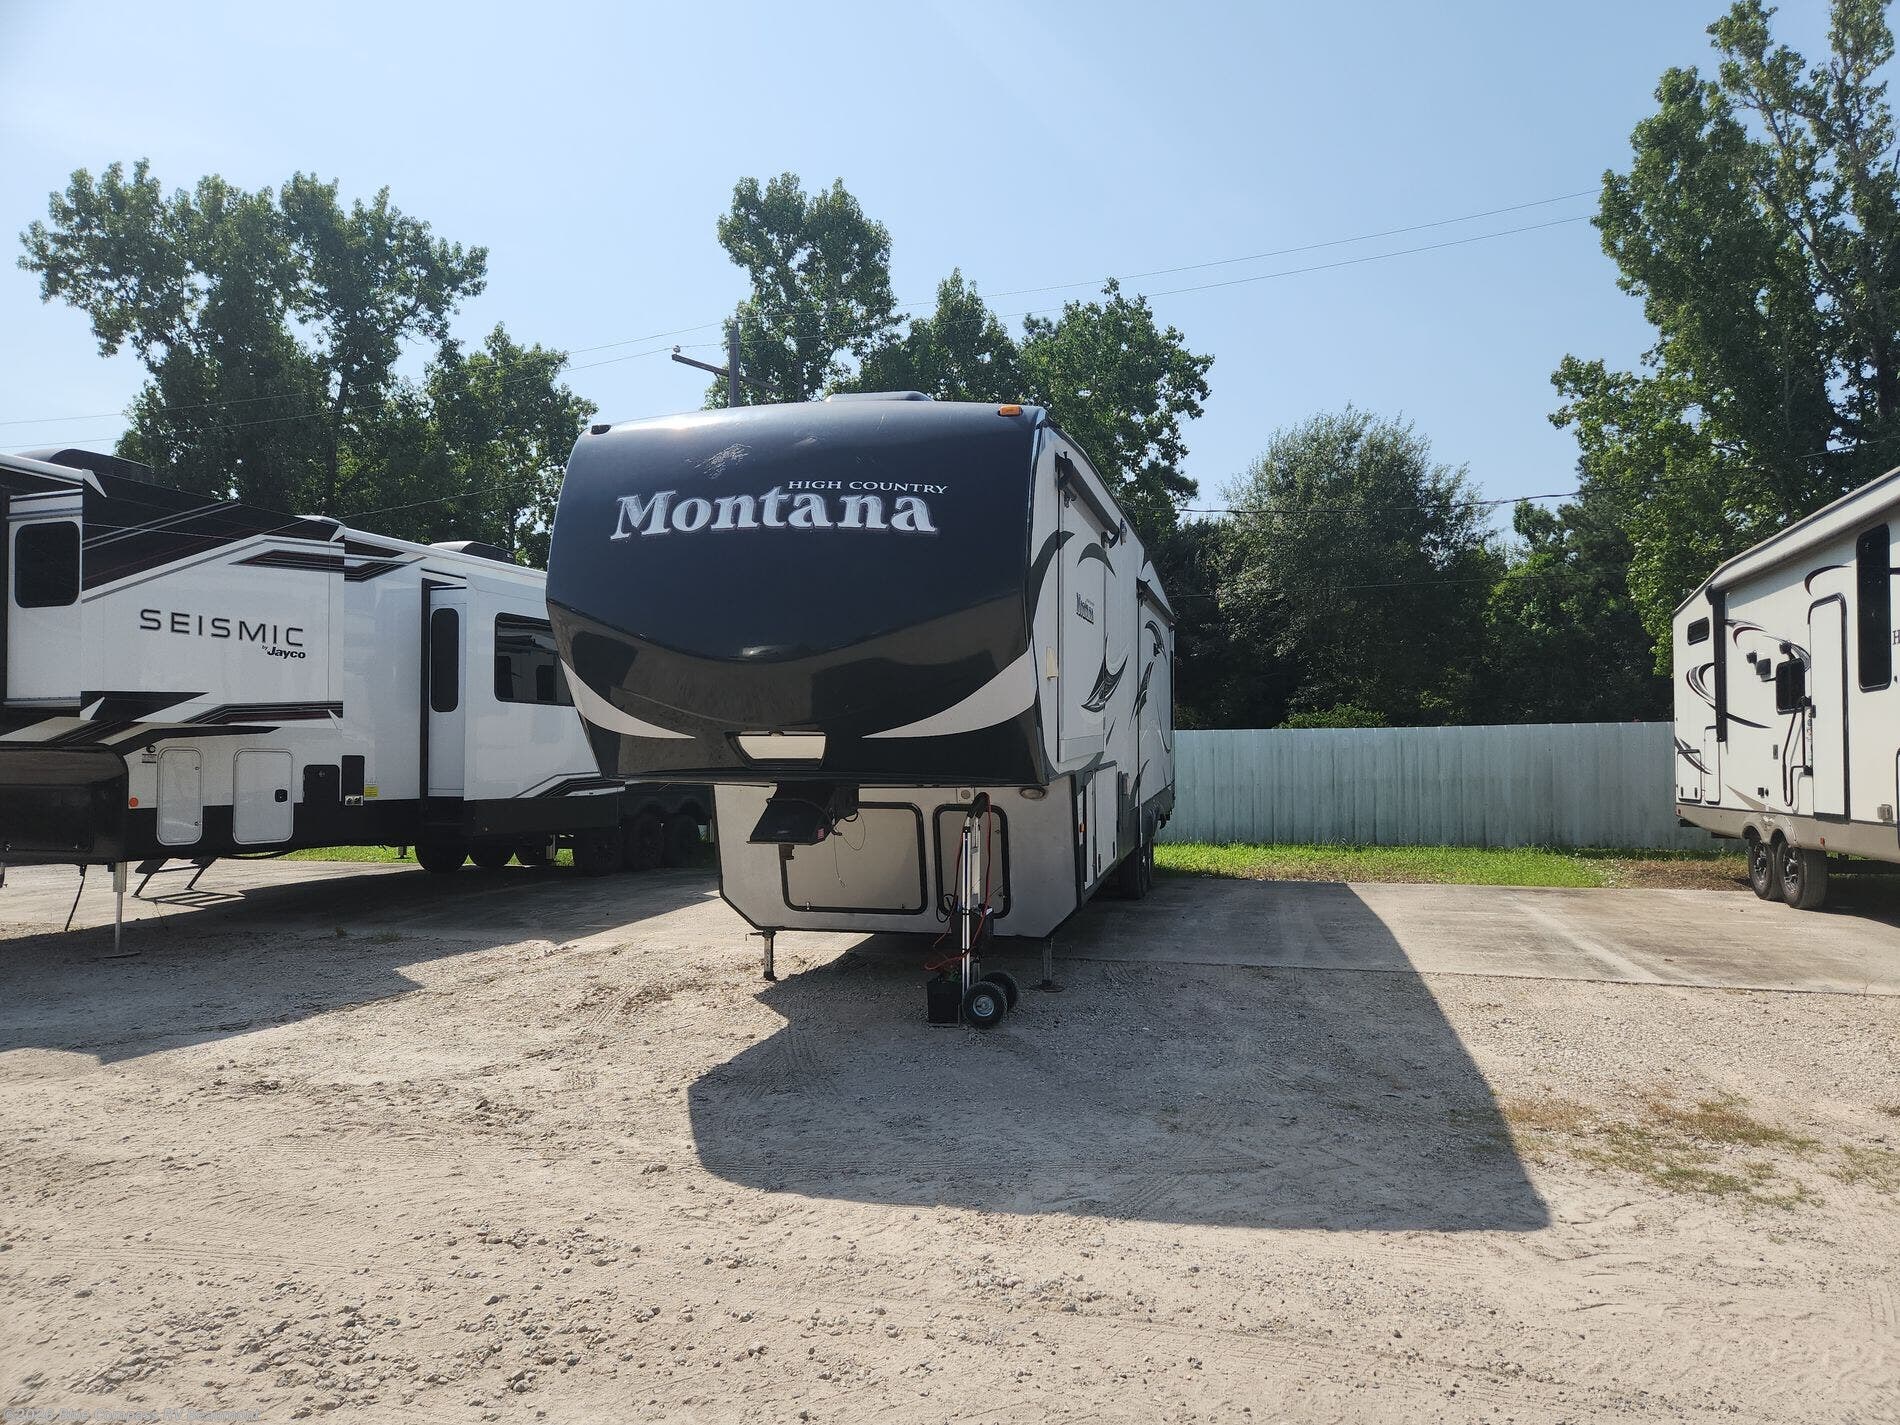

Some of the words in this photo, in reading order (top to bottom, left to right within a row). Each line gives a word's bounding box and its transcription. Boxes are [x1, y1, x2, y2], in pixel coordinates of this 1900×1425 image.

[788, 480, 842, 490] HIGH
[849, 481, 949, 494] COUNTRY
[609, 485, 941, 542] Montana
[139, 608, 304, 647] SEISMIC
[266, 647, 307, 660] Jayco
